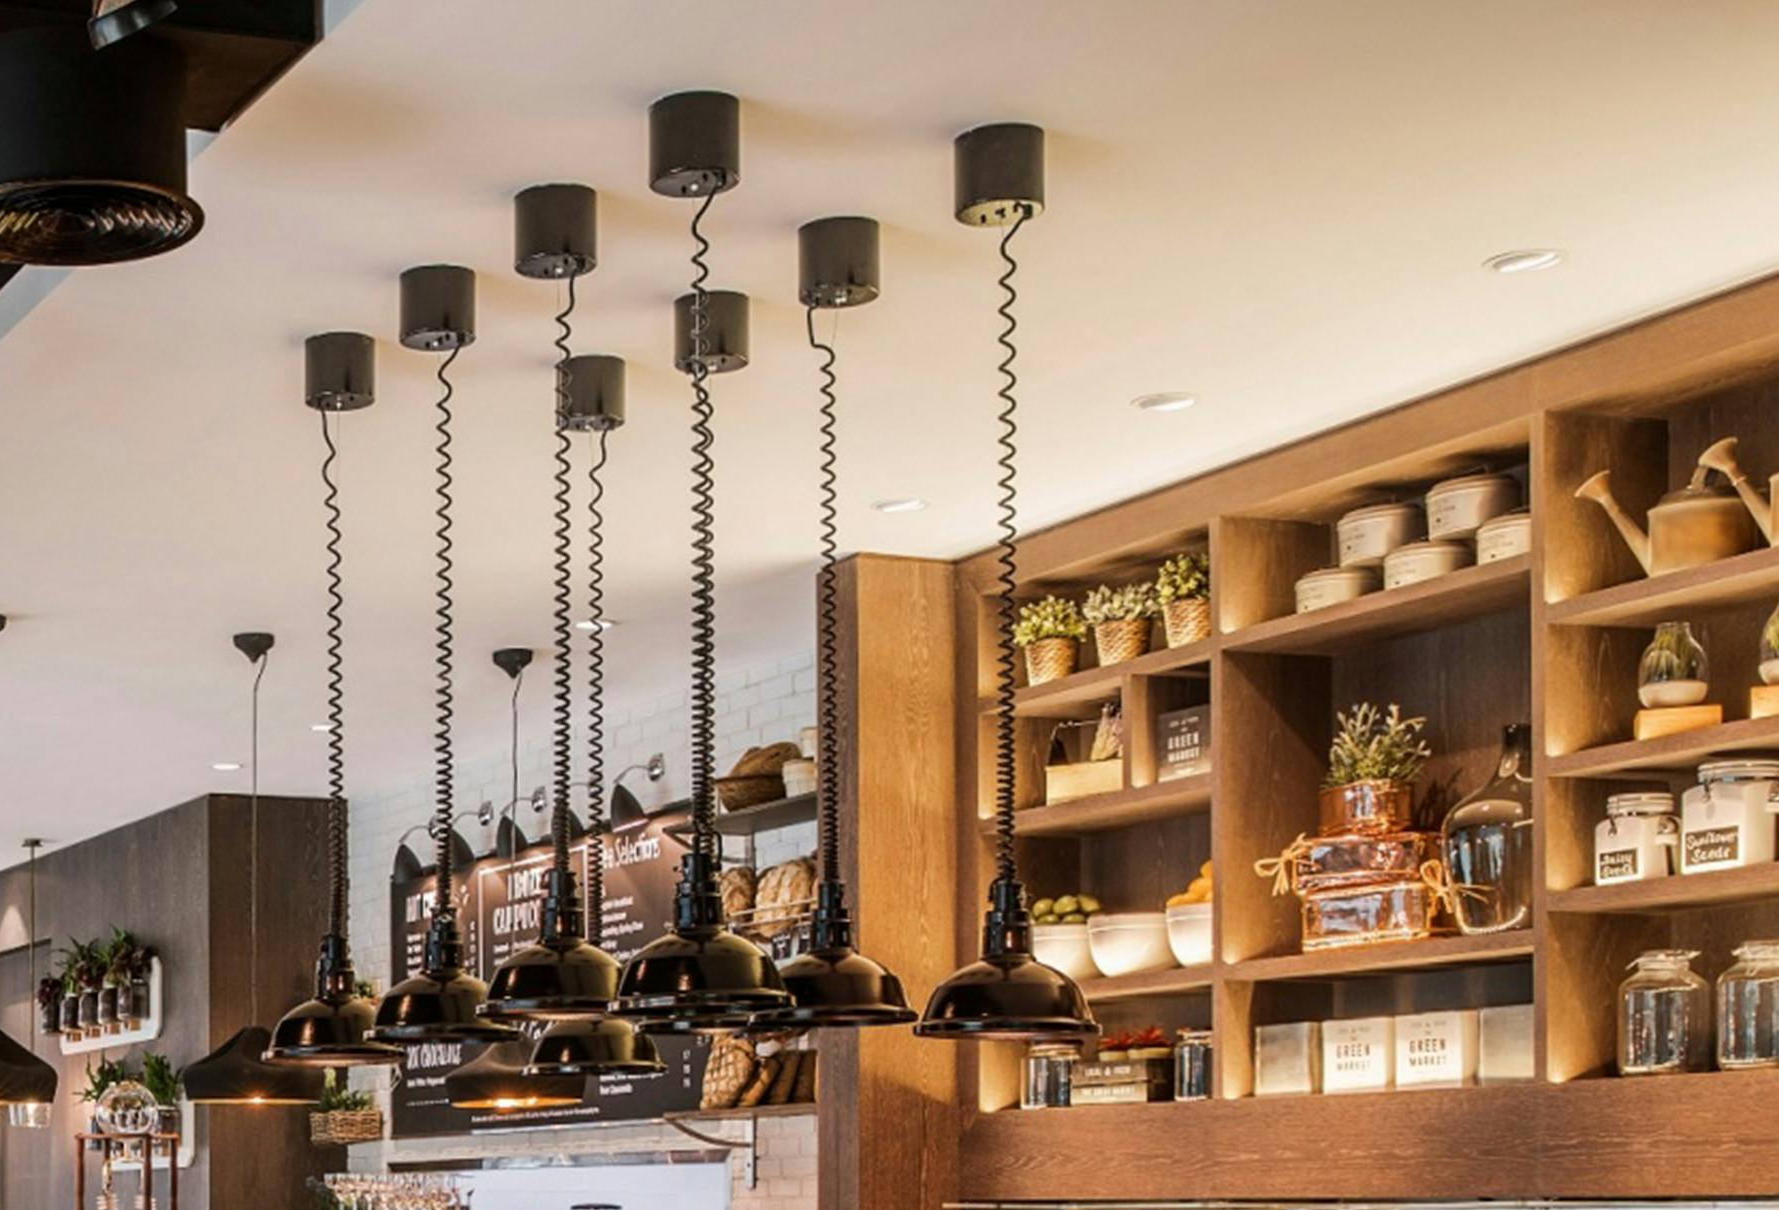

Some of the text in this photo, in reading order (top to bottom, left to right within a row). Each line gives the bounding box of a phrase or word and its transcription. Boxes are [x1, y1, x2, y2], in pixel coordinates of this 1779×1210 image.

[1167, 732, 1199, 750] GREEN
[1336, 1044, 1371, 1059] GREEN
[1409, 1038, 1446, 1054] GREEN
[1337, 1060, 1371, 1072] MARKET
[1409, 1055, 1447, 1067] MARKET
